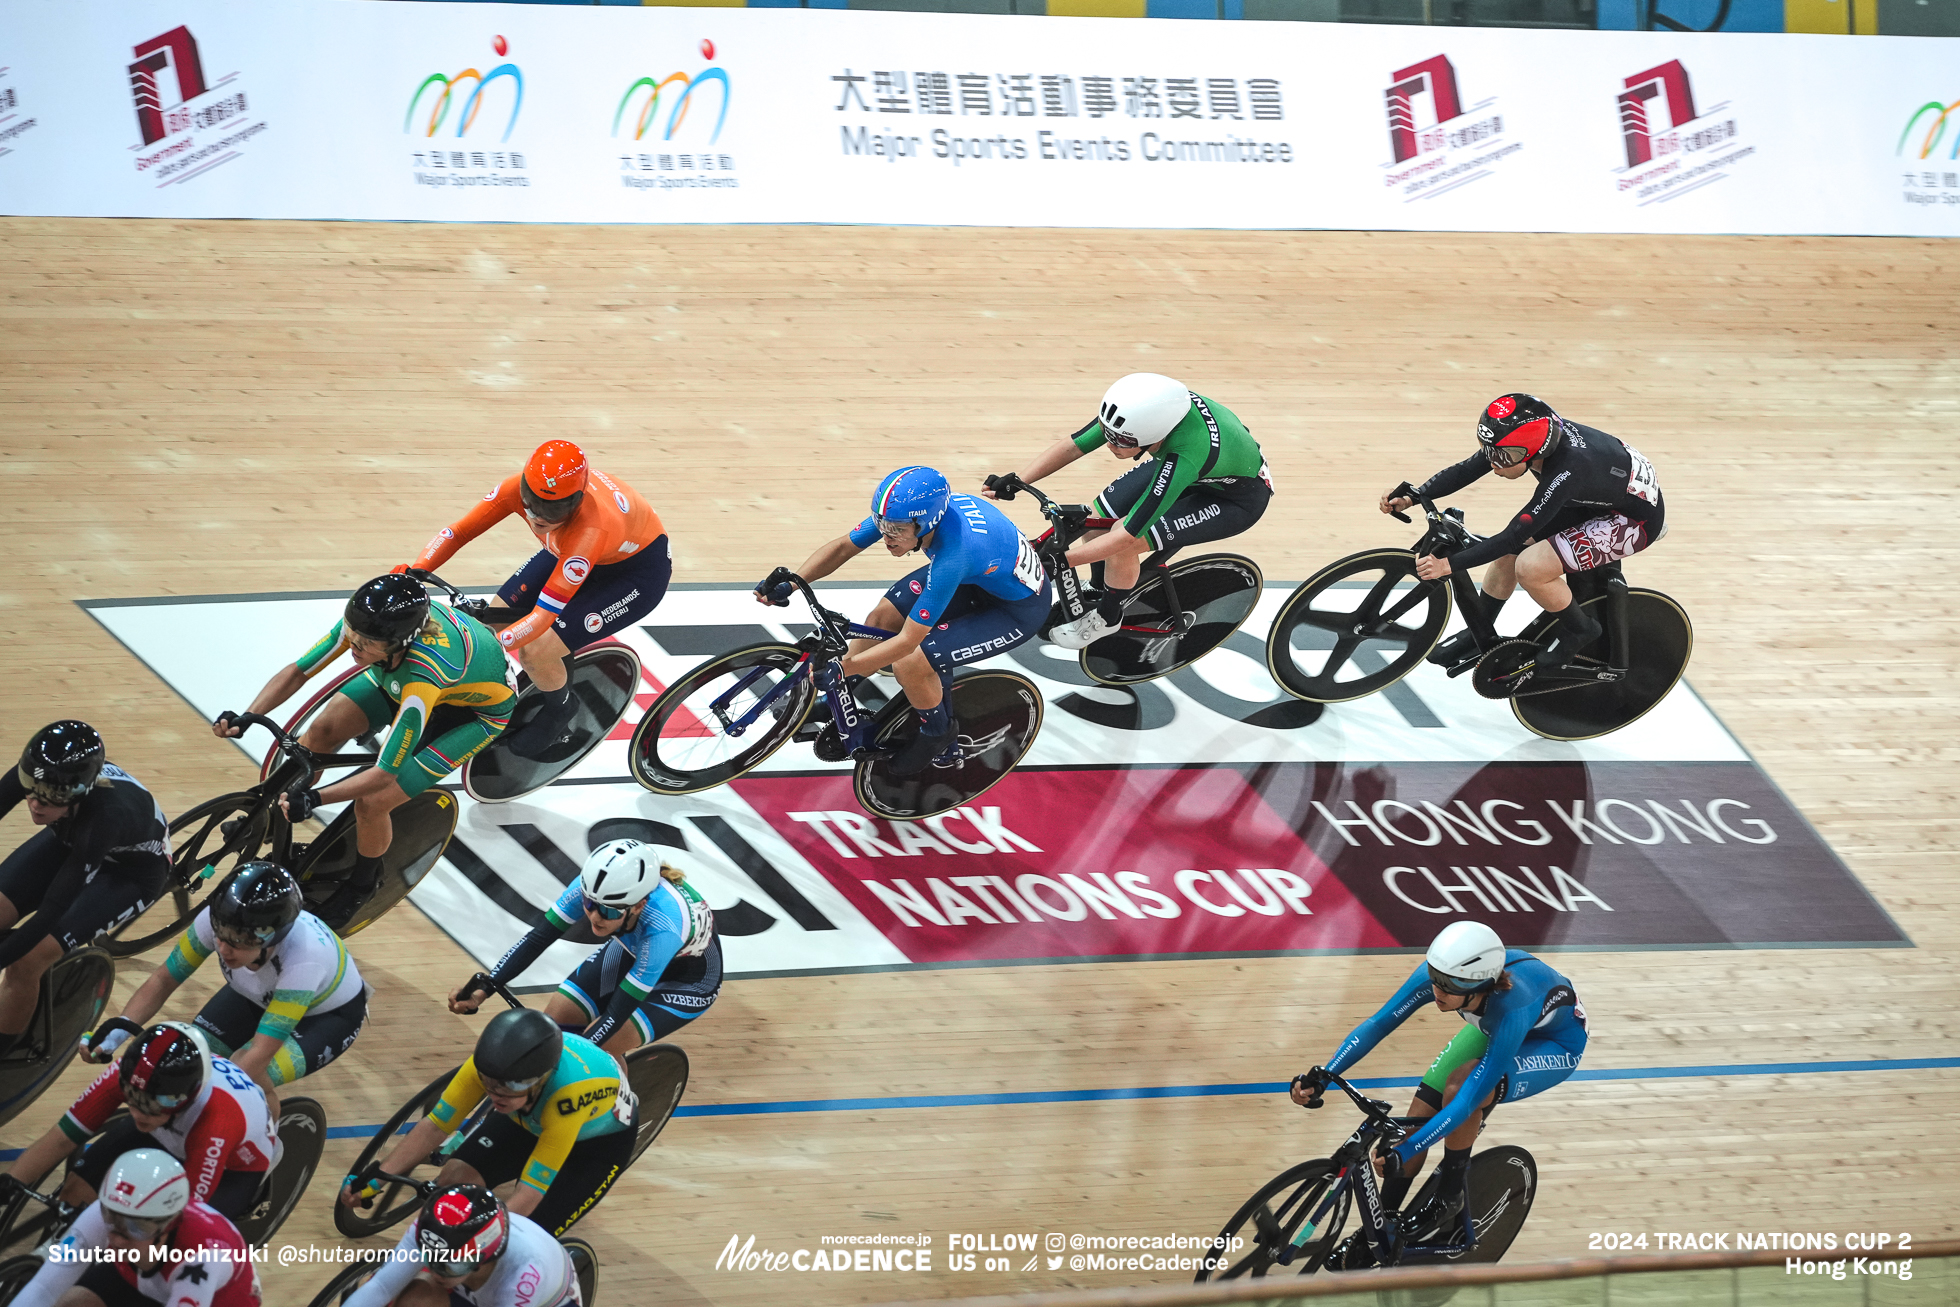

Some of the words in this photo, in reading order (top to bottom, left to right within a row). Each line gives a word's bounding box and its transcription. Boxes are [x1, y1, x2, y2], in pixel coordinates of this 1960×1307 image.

[831, 68, 1285, 121] 大型體育活動事務委員會
[840, 125, 921, 162] Major
[932, 128, 1028, 166] Sports
[1037, 129, 1131, 161] Events
[1139, 131, 1293, 163] Committee
[1153, 461, 1174, 496] IRELAND
[908, 509, 928, 518] ITALIA
[1174, 503, 1221, 531] IRELAND
[601, 588, 640, 617] NEDERLANDSE
[604, 606, 629, 624] LOTERIJ
[392, 747, 407, 768] AFRICA
[401, 728, 414, 749] SOUTH
[786, 806, 1045, 859] TRACK
[1311, 798, 1553, 847] HONG
[1546, 797, 1779, 845] KONG
[861, 869, 1181, 928] NATIONS
[1173, 868, 1314, 917] CUP
[1382, 865, 1616, 914] CHINA
[554, 1164, 619, 1237] QAZAQSTAN
[1360, 1161, 1384, 1230] PINARELLO
